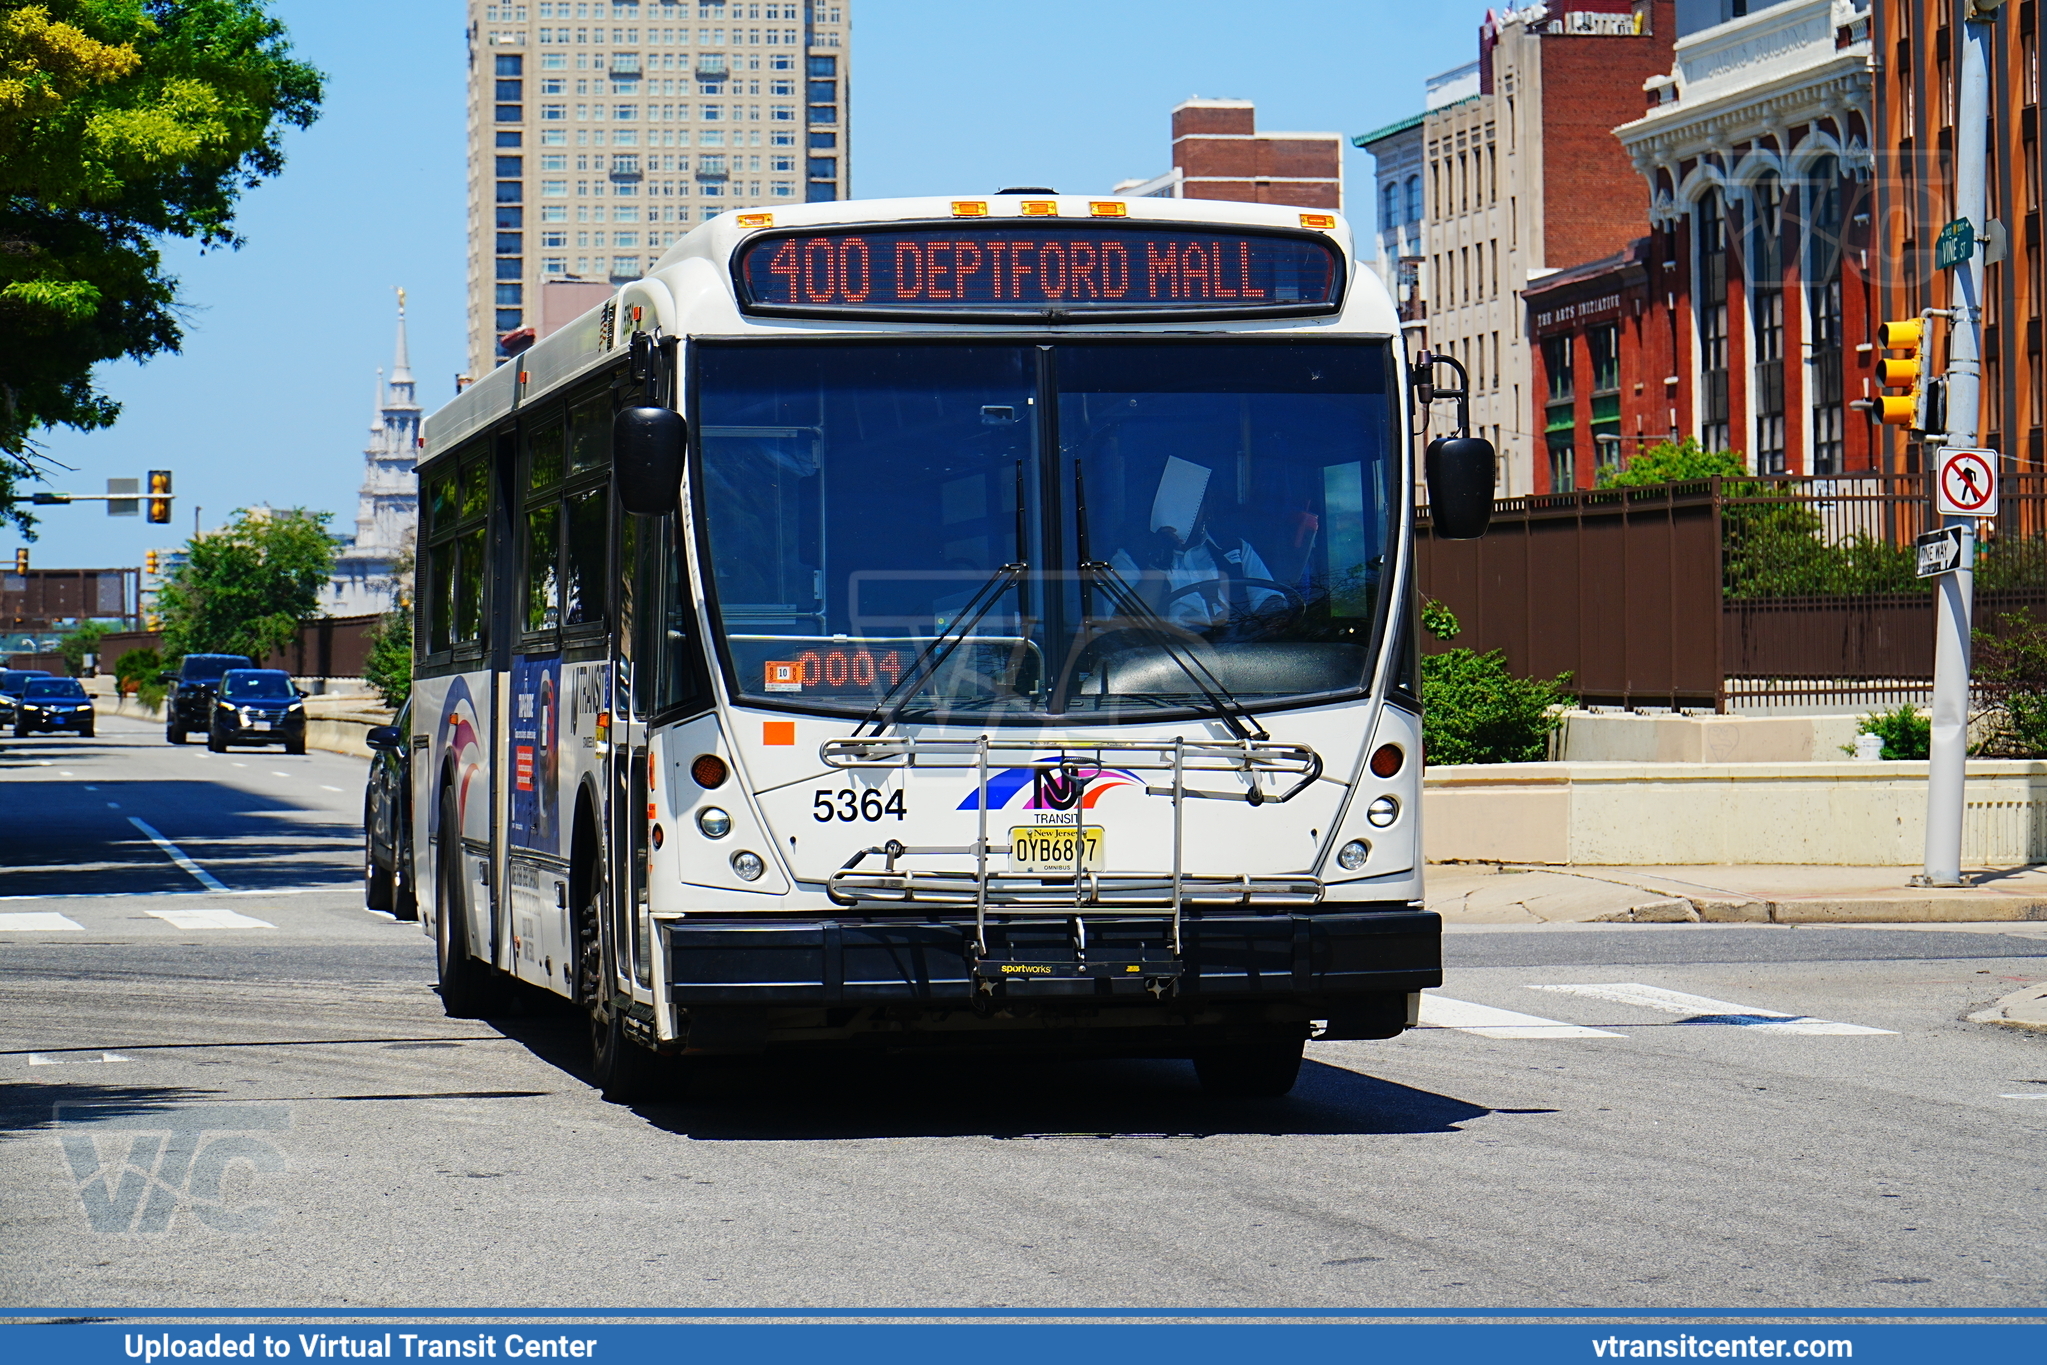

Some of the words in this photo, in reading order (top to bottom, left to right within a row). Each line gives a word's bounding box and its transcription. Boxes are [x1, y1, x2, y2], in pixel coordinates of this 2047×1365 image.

[1942, 237, 1958, 265] VINE
[1960, 241, 1966, 259] ST
[770, 238, 869, 302] 400
[896, 242, 1128, 298] DEPTFORD
[1148, 242, 1264, 298] MALL
[1537, 312, 1552, 328] THE
[1555, 305, 1575, 323] ARTS
[1578, 294, 1620, 317] INITIATIVE
[1935, 541, 1949, 560] WAY
[779, 668, 787, 677] 10
[800, 651, 900, 686] 0004
[813, 788, 907, 822] 5364
[1034, 829, 1055, 837] New
[1001, 964, 1052, 974] sportworks
